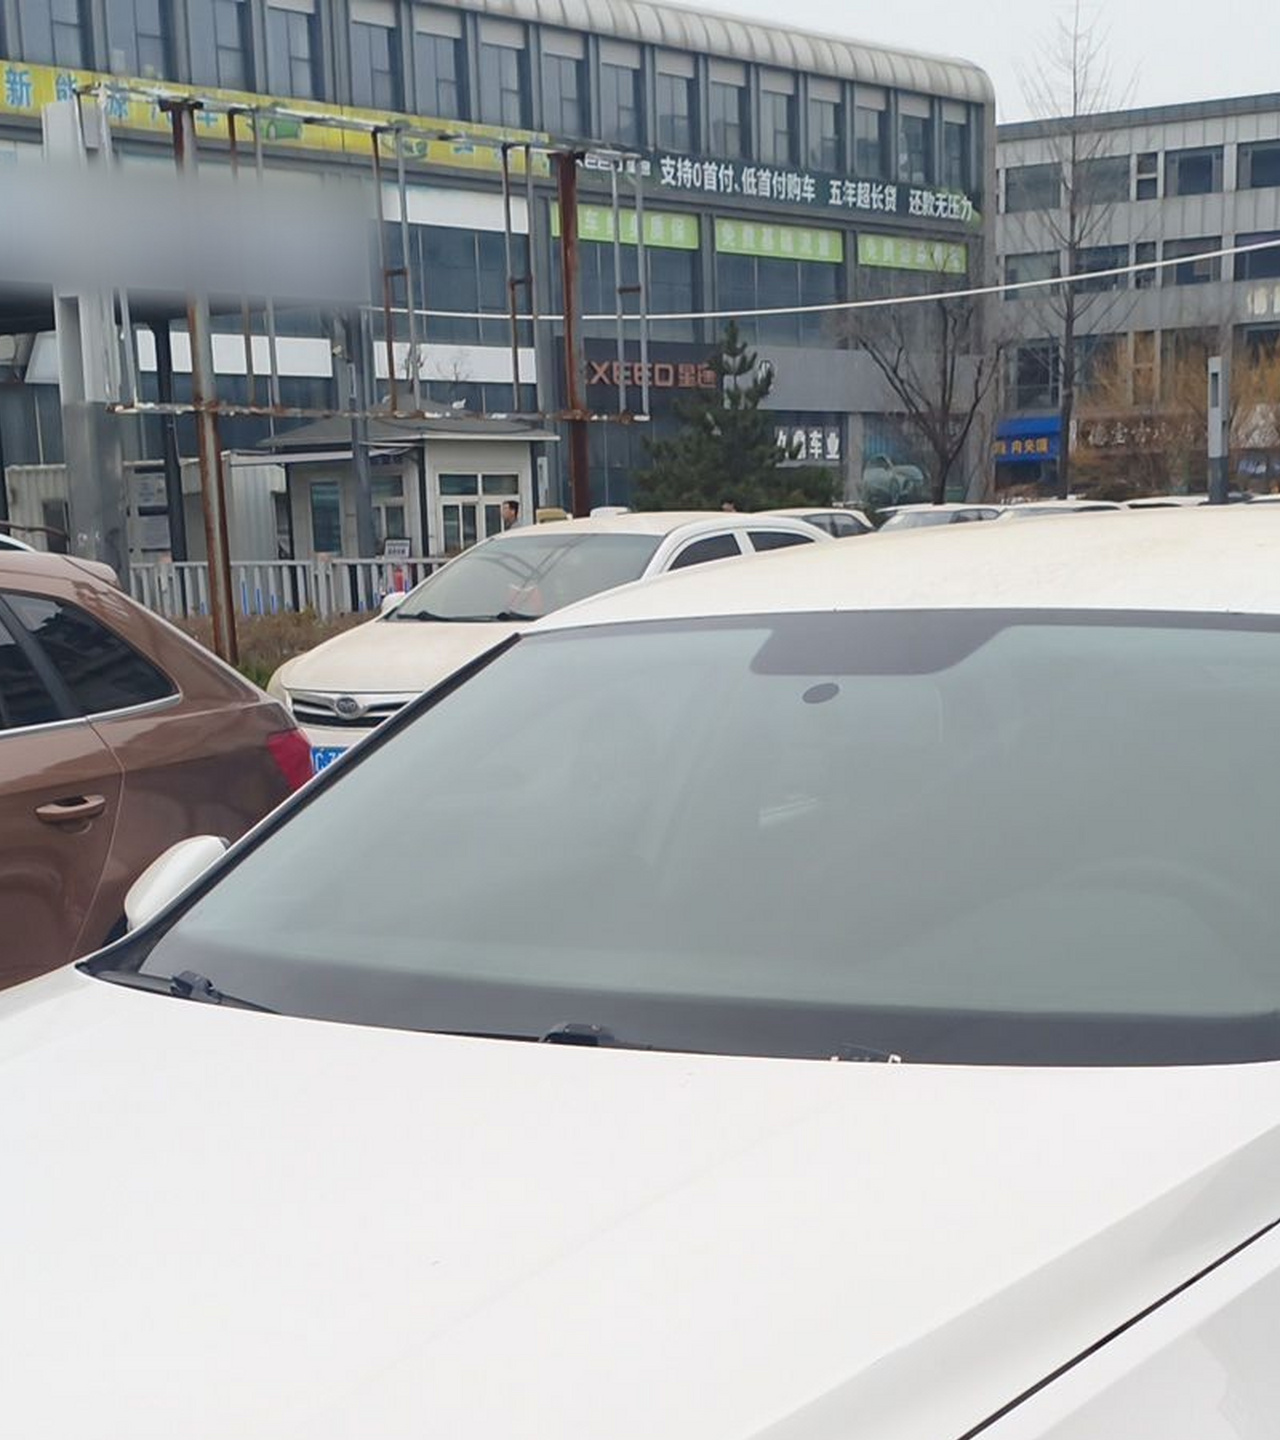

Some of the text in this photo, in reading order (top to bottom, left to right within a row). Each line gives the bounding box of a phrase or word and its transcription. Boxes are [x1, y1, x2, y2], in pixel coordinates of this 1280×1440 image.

[660, 156, 815, 203] 支持0首付、低首付购车
[828, 179, 898, 212] 五年超长贷
